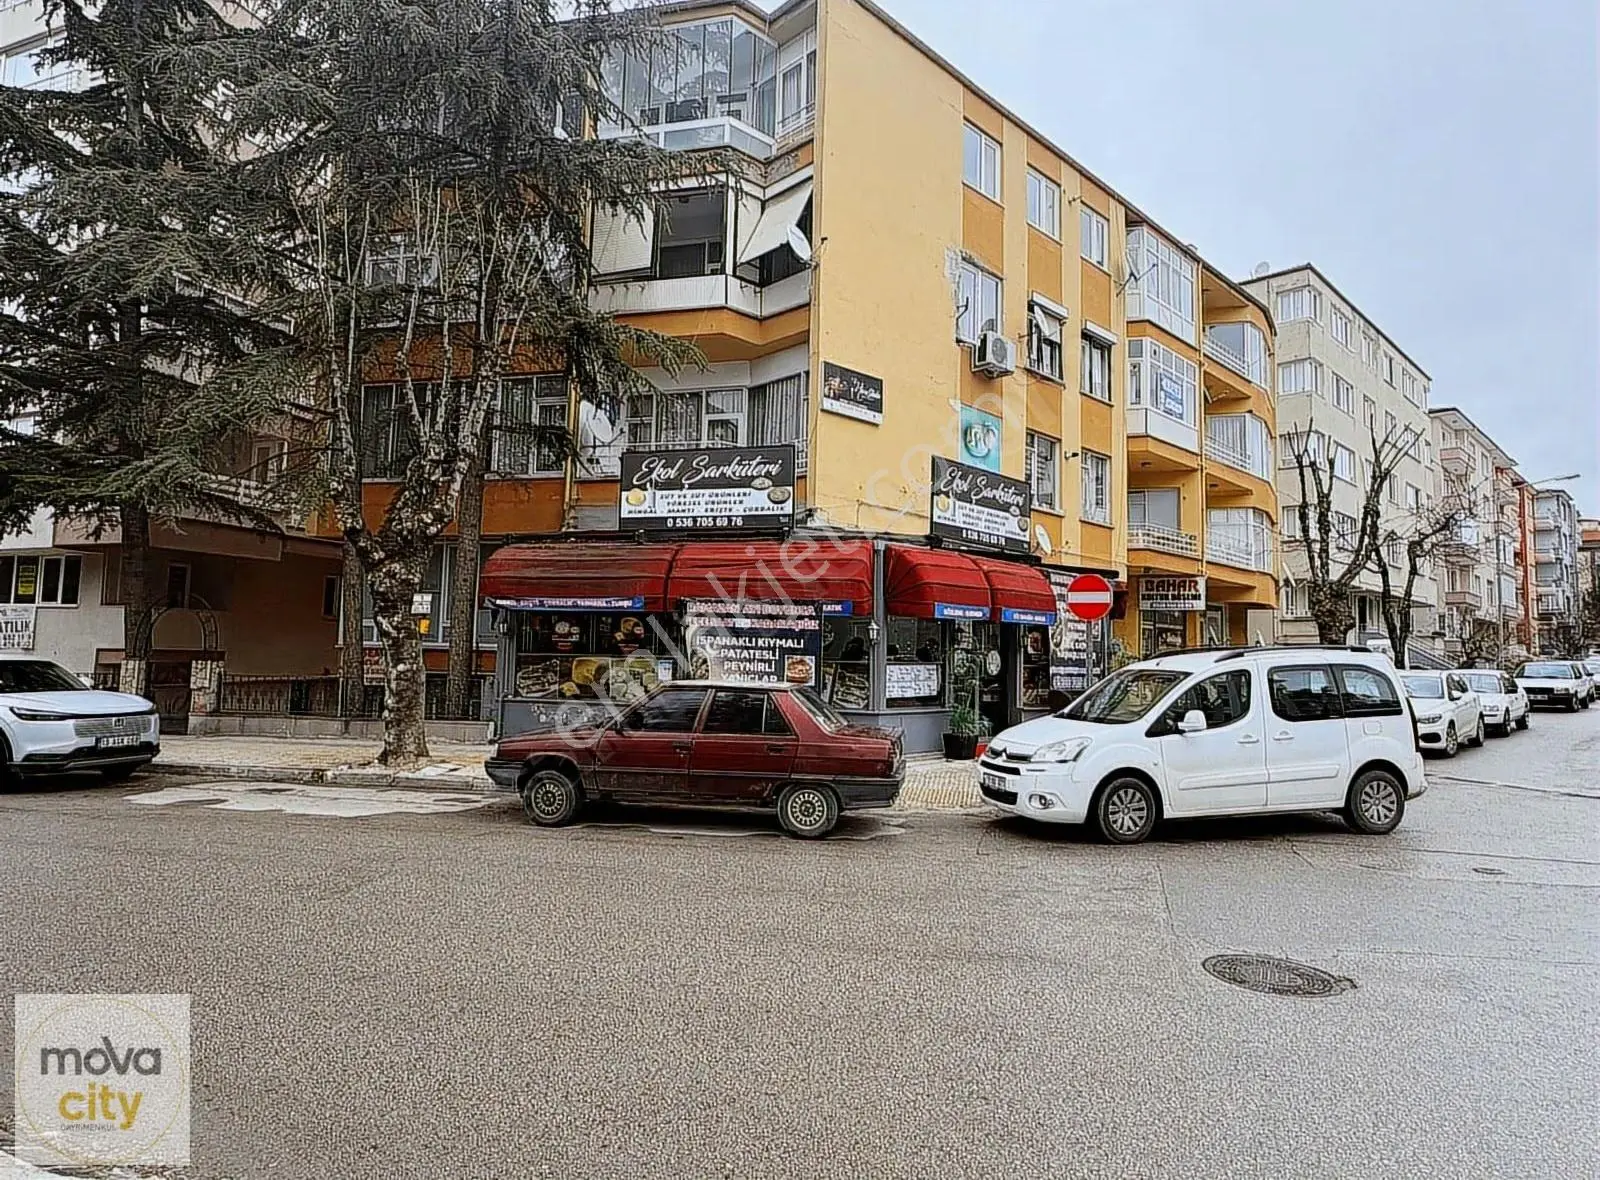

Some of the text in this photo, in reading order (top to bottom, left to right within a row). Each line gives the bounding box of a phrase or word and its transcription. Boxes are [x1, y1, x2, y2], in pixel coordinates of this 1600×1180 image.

[632, 456, 684, 485] Ekol
[940, 466, 973, 494] Ekol
[667, 518, 674, 527] 0
[676, 518, 694, 527] 536
[696, 517, 714, 527] 705
[731, 517, 743, 526] 76
[1144, 579, 1201, 593] BAHAR
[757, 637, 804, 648] KIYMALI
